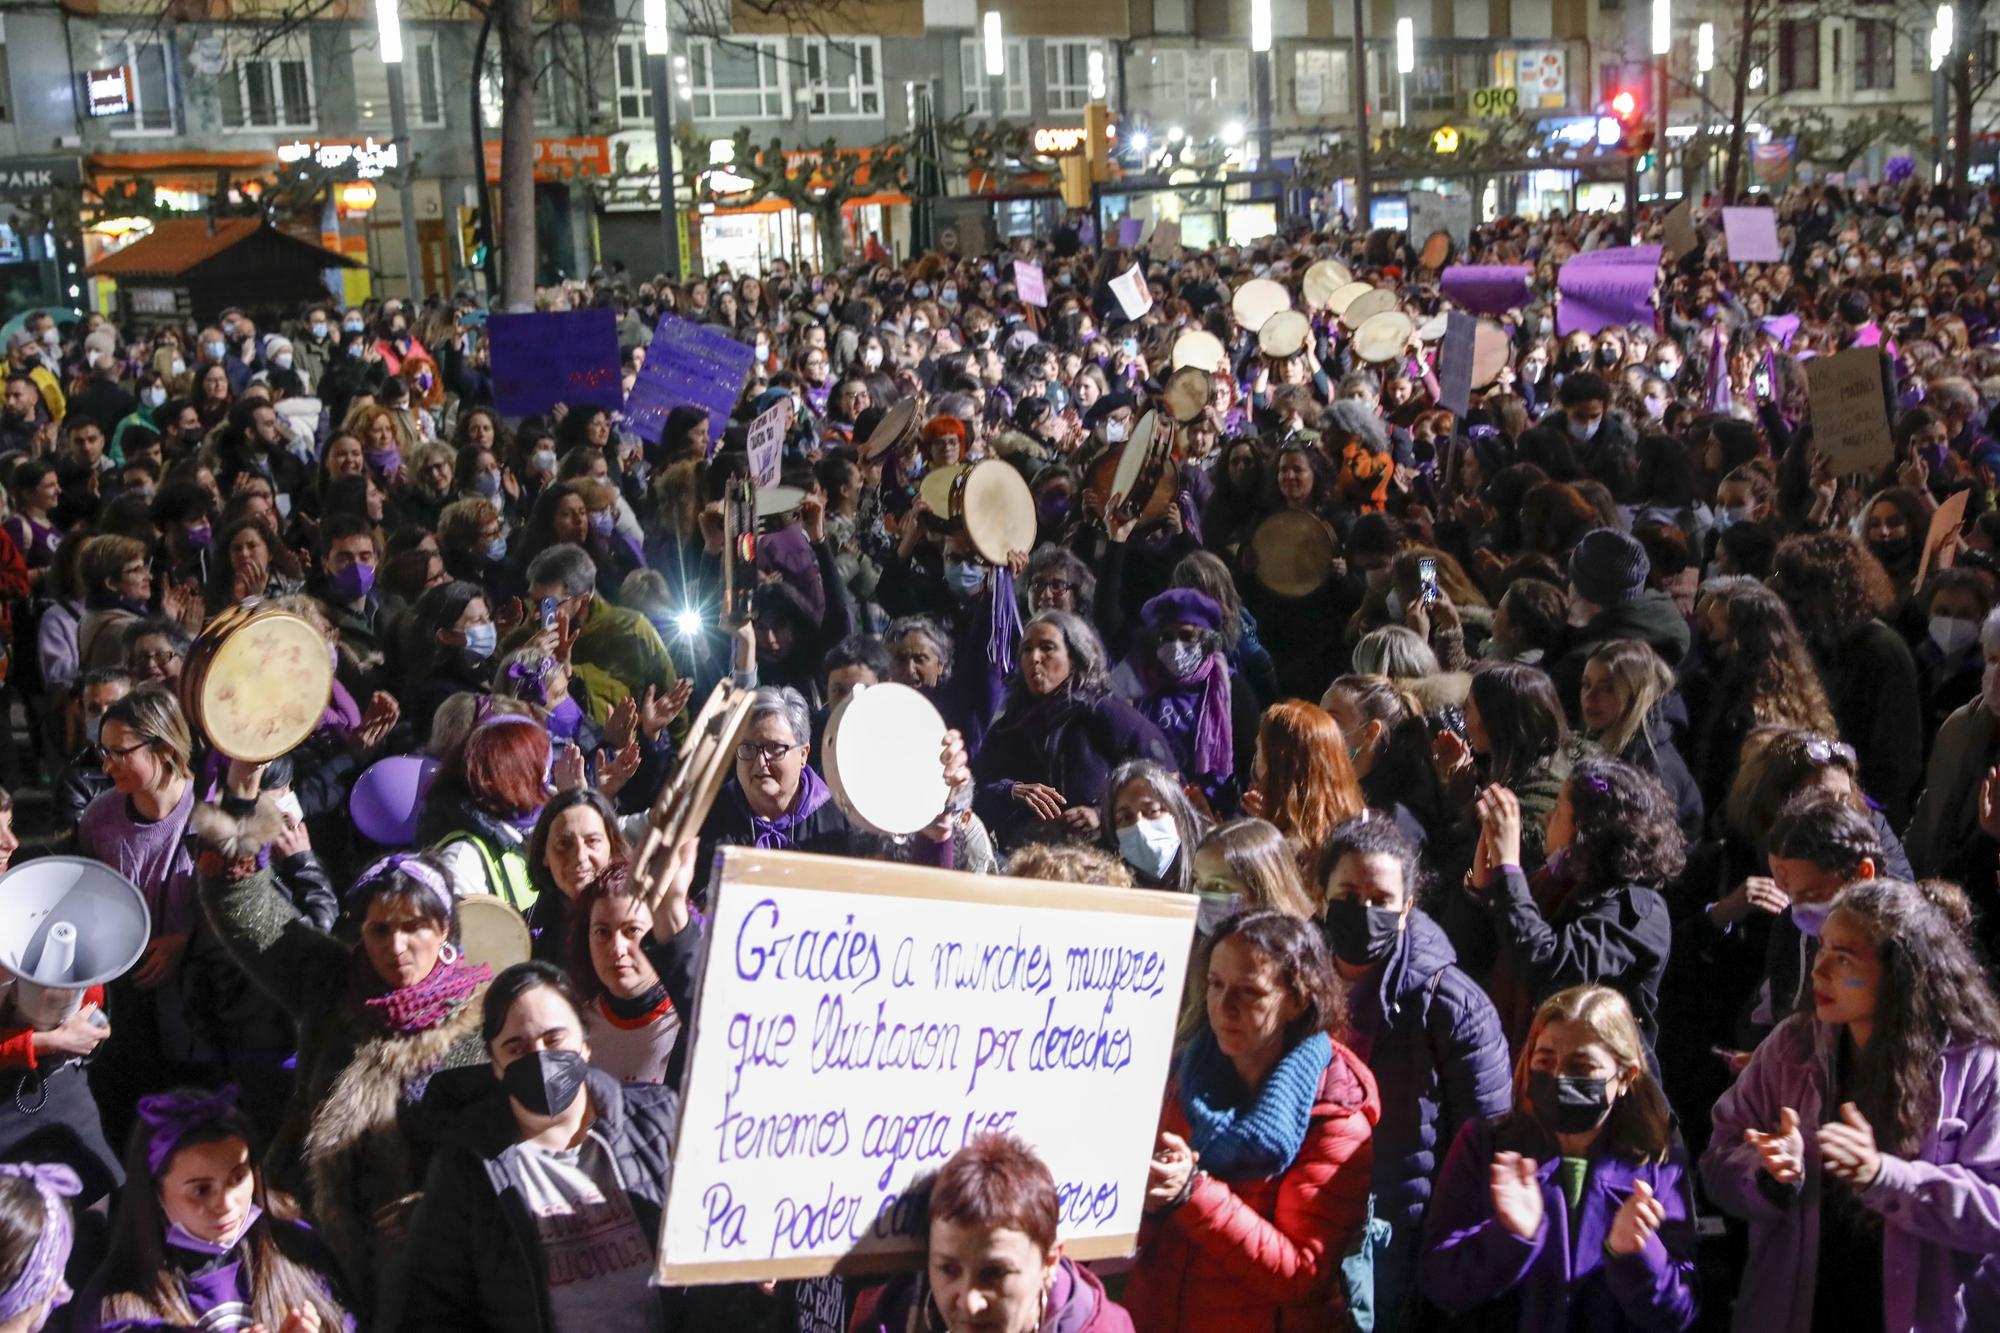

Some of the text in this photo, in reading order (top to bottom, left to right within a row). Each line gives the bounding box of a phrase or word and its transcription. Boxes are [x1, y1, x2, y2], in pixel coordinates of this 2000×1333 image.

[1473, 87, 1518, 110] ORO
[735, 898, 881, 994] Gracies
[892, 936, 915, 988] a
[728, 1012, 797, 1098] que
[966, 1026, 1023, 1096] por
[1029, 996, 1132, 1075] derechos
[715, 1092, 850, 1163] tenemos
[862, 1110, 952, 1191] agora
[702, 1183, 747, 1252] Pa
[769, 1181, 862, 1258] poder
